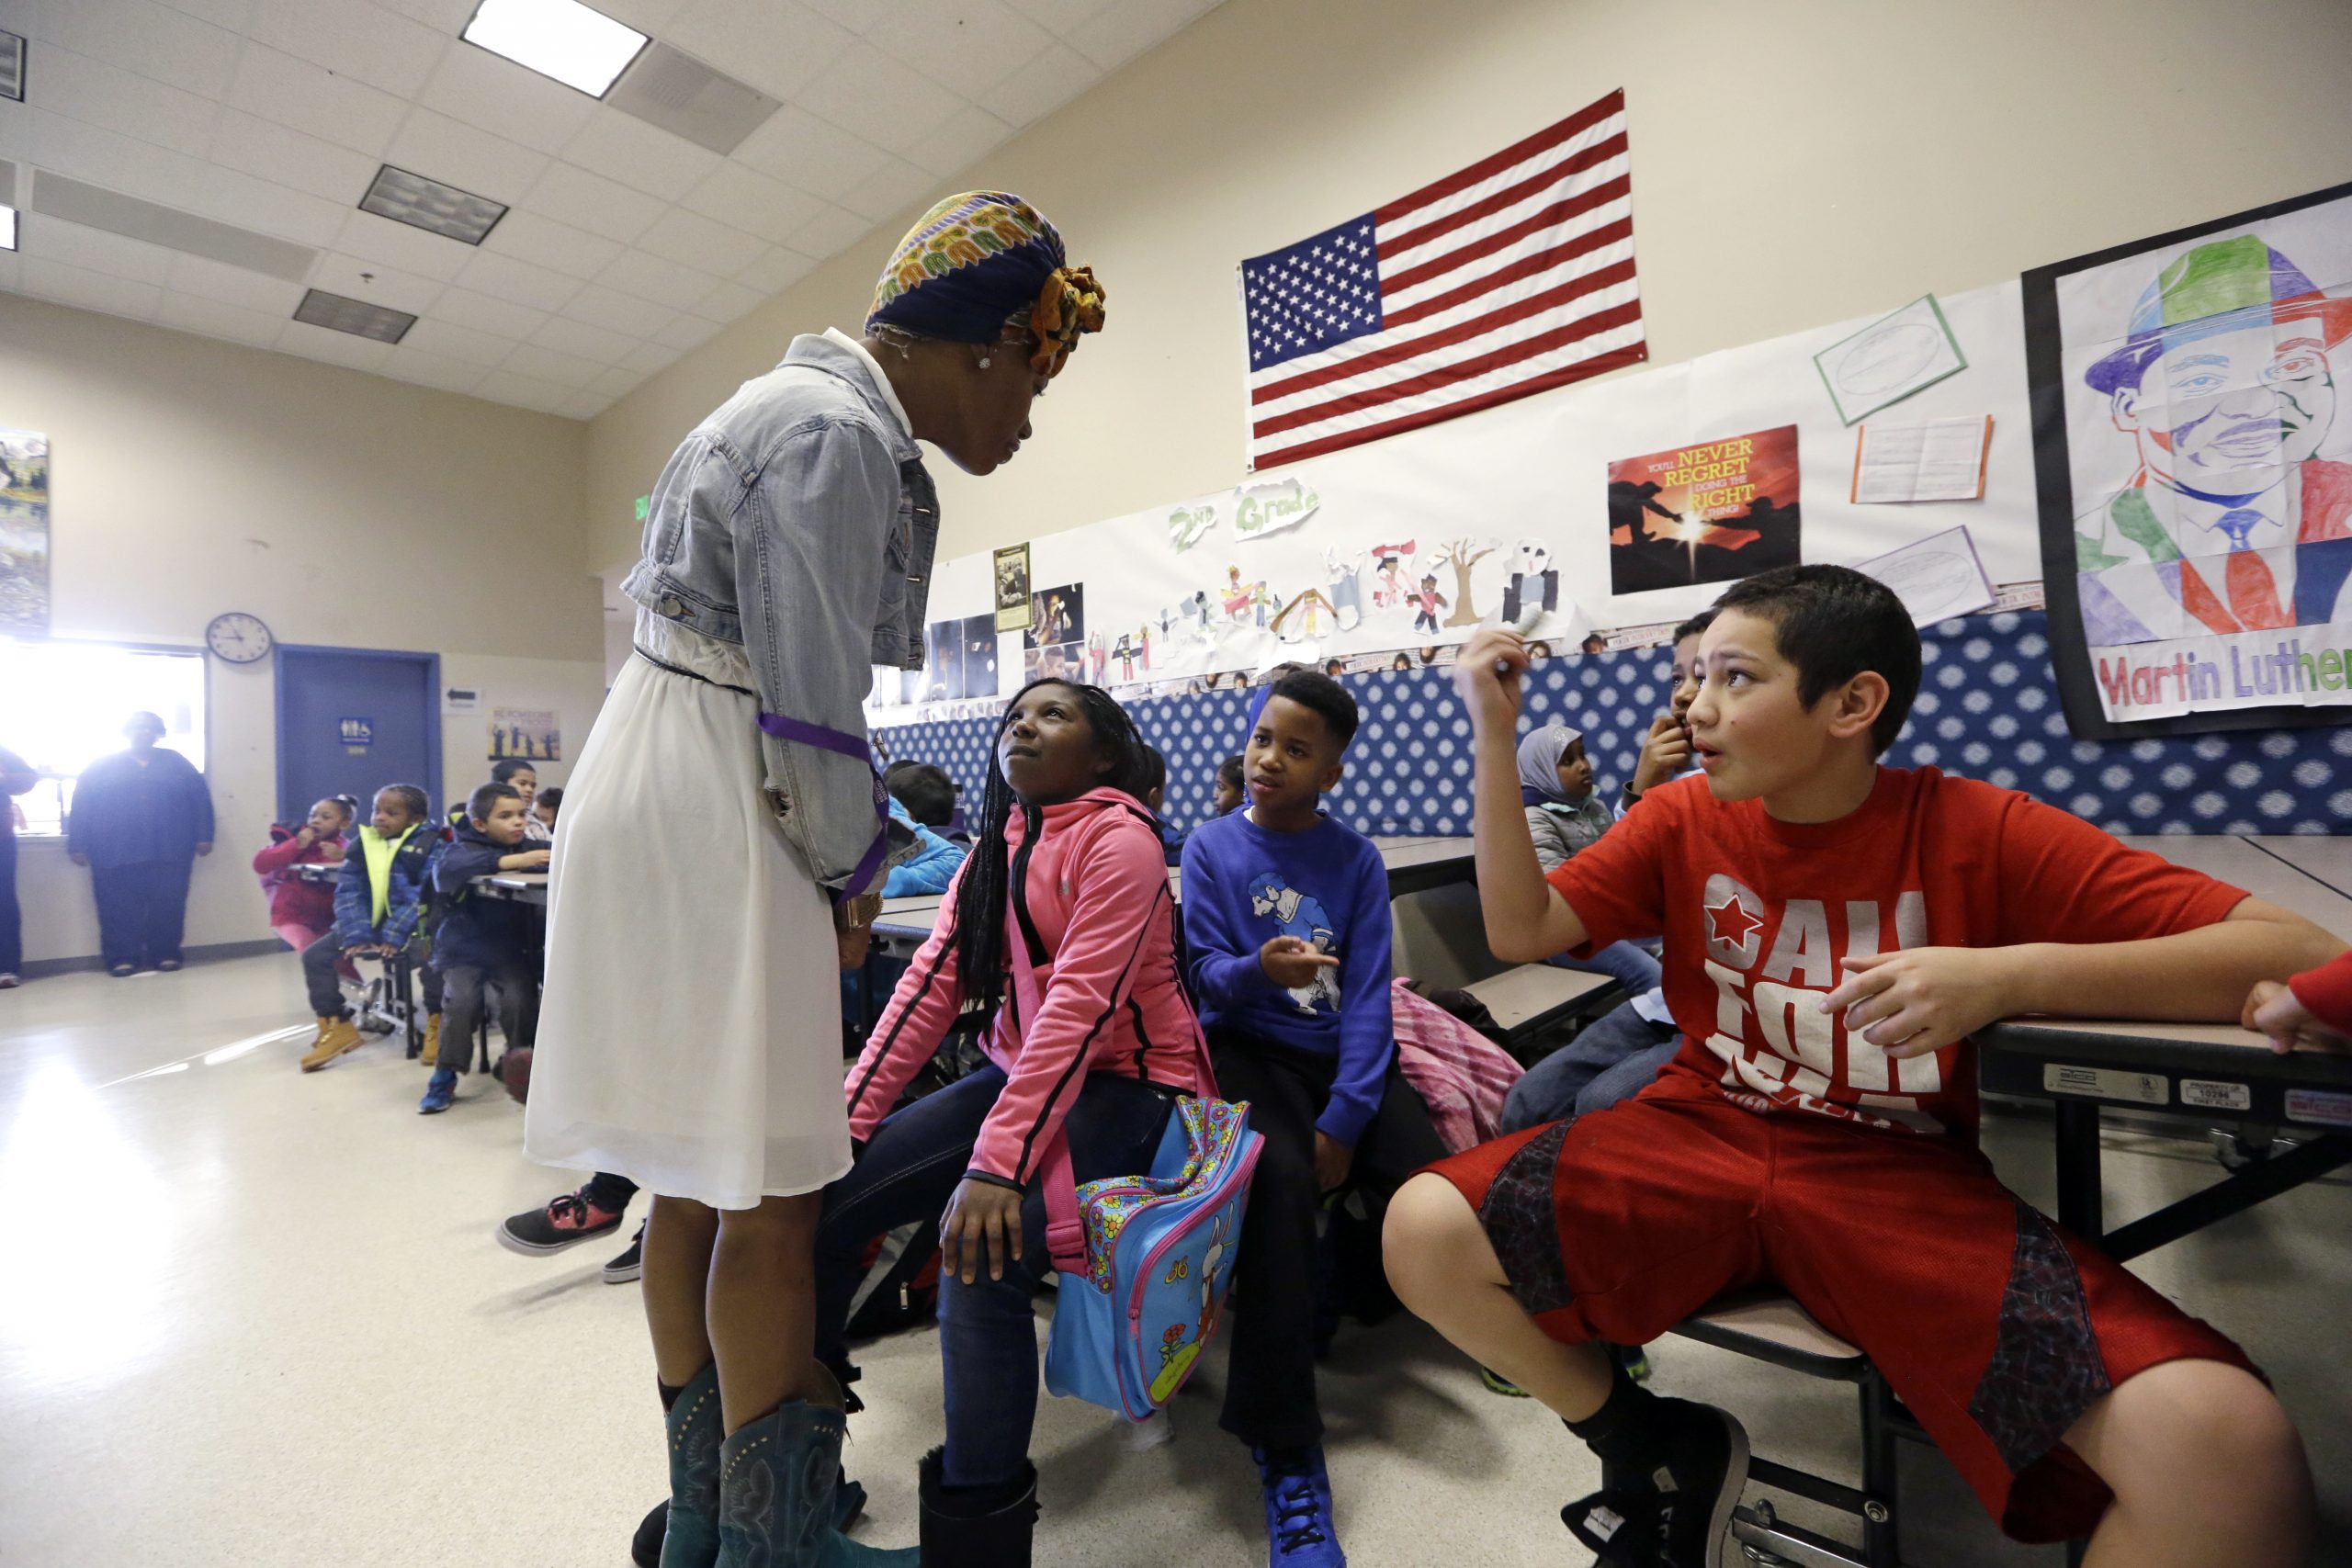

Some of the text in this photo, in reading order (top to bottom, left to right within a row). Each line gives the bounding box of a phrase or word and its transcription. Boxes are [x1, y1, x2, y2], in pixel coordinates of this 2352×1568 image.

[1648, 438, 1753, 473] YOU'LL NEVER
[1665, 457, 1750, 487] REGRET
[1694, 475, 1747, 492] DOING THE
[1236, 486, 1319, 532] Grade
[1690, 484, 1755, 509] RIGHT
[2098, 651, 2221, 706] Martin
